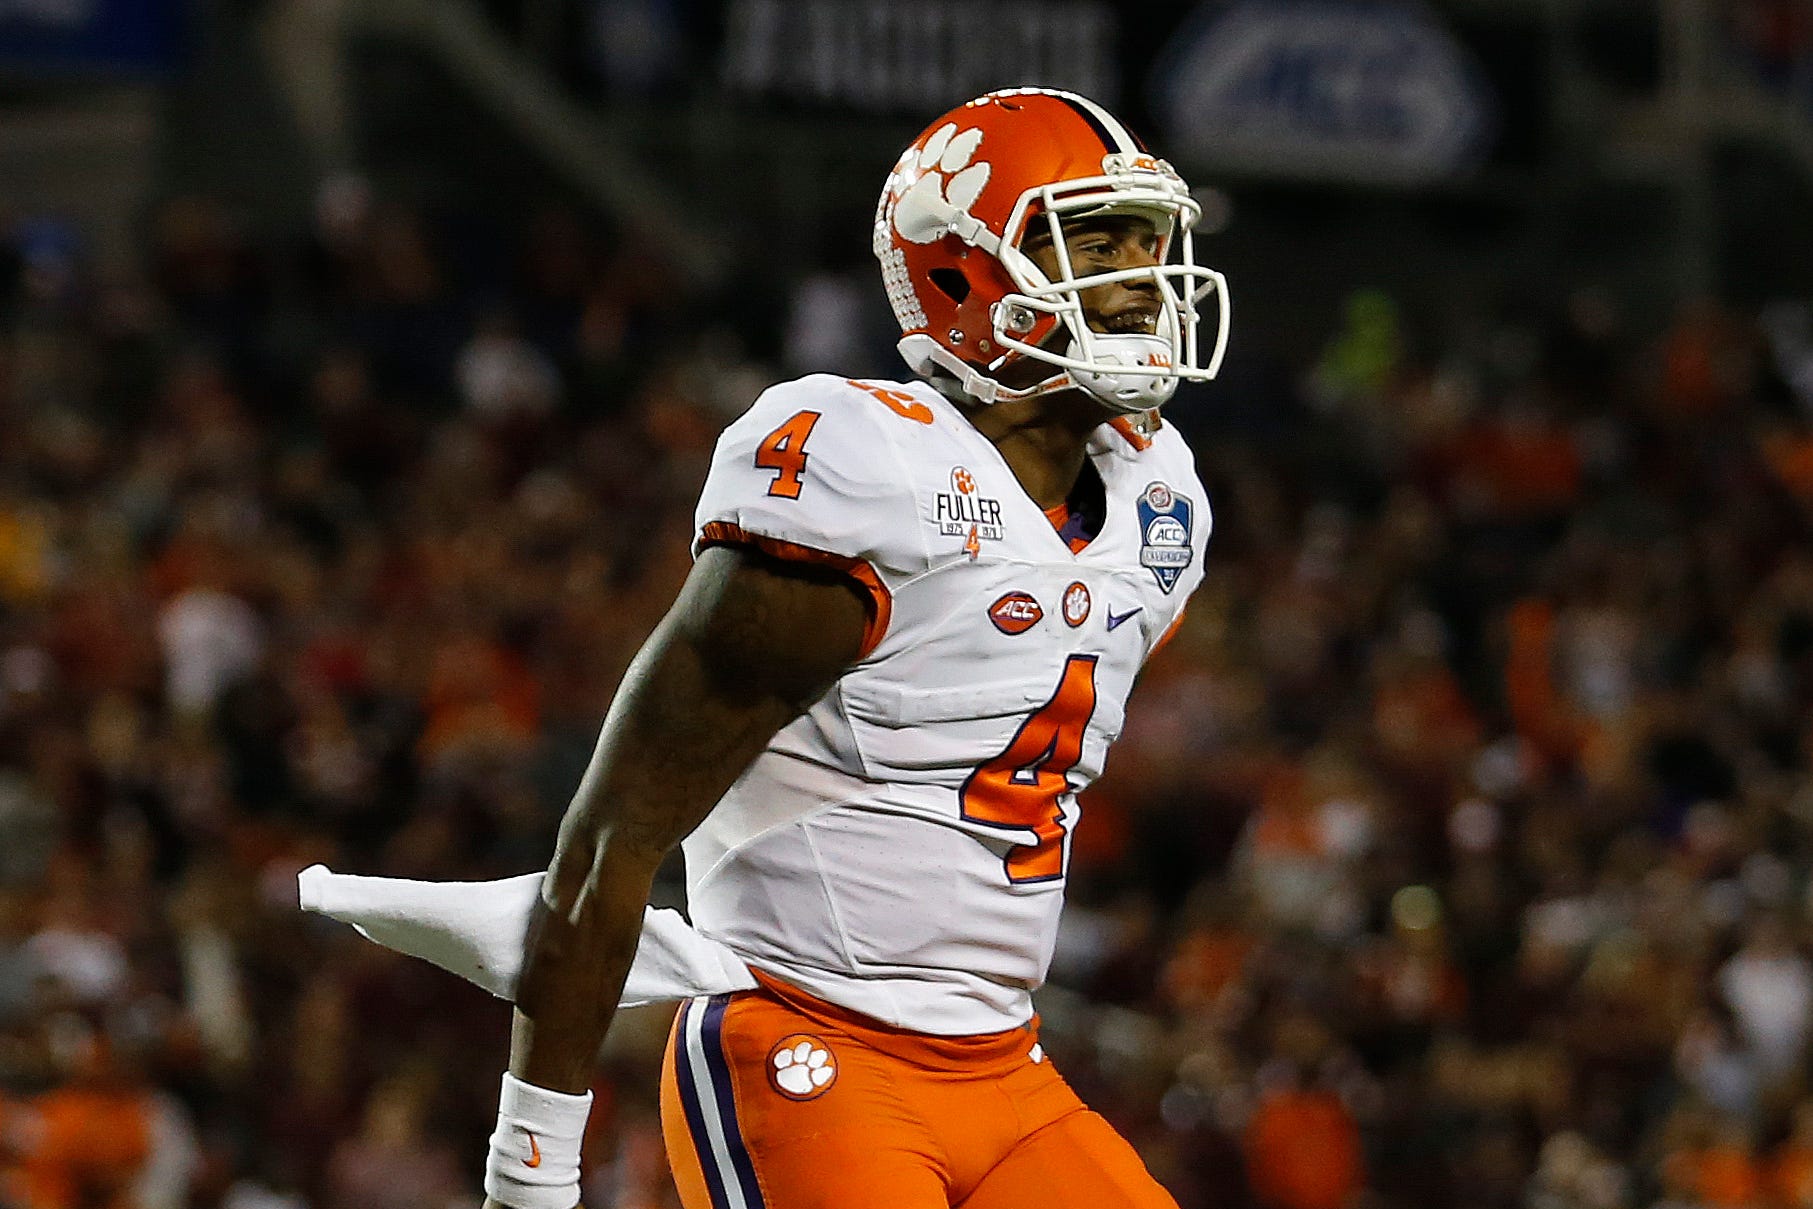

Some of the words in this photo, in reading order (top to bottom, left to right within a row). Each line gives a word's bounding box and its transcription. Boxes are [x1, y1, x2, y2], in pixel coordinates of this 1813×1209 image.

[754, 409, 822, 500] 4
[937, 493, 1002, 525] FULLER
[961, 524, 980, 561] 4
[1155, 528, 1181, 541] ACC
[996, 600, 1039, 619] ACC
[959, 654, 1099, 884] 4
